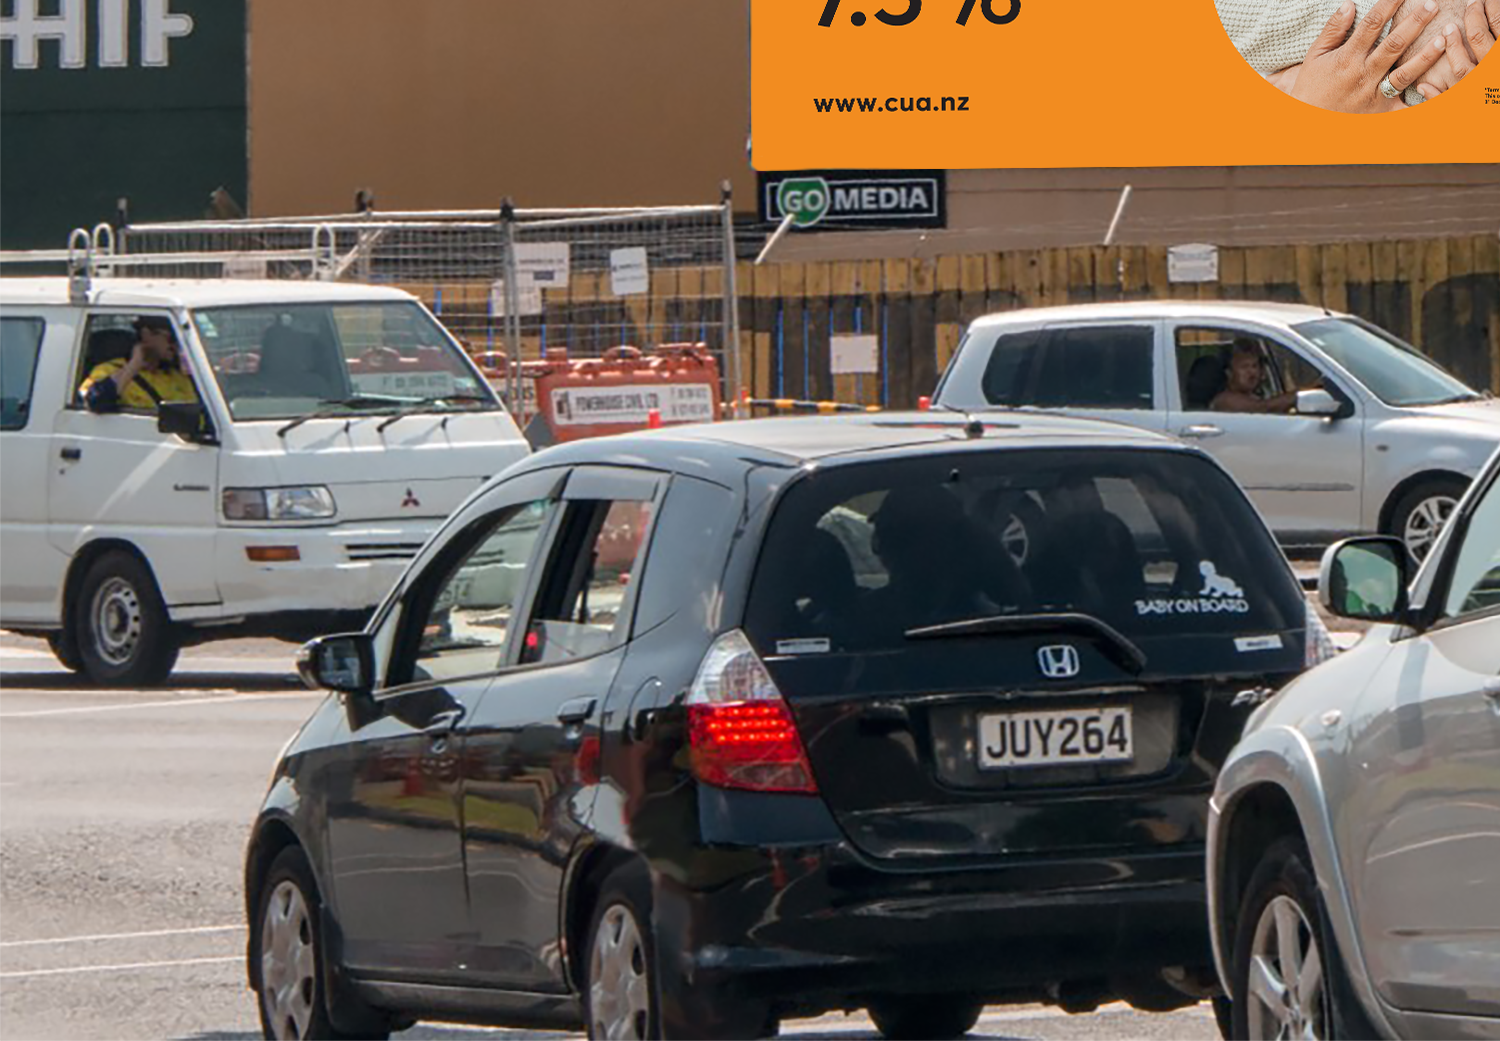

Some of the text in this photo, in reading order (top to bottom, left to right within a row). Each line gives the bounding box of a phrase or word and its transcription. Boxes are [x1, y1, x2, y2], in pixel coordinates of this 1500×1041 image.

[813, 95, 970, 113] www.cua.nz
[784, 186, 929, 213] GO MEDIA
[1134, 598, 1249, 615] BABY ON BOARD
[985, 714, 1128, 759] JUY264
